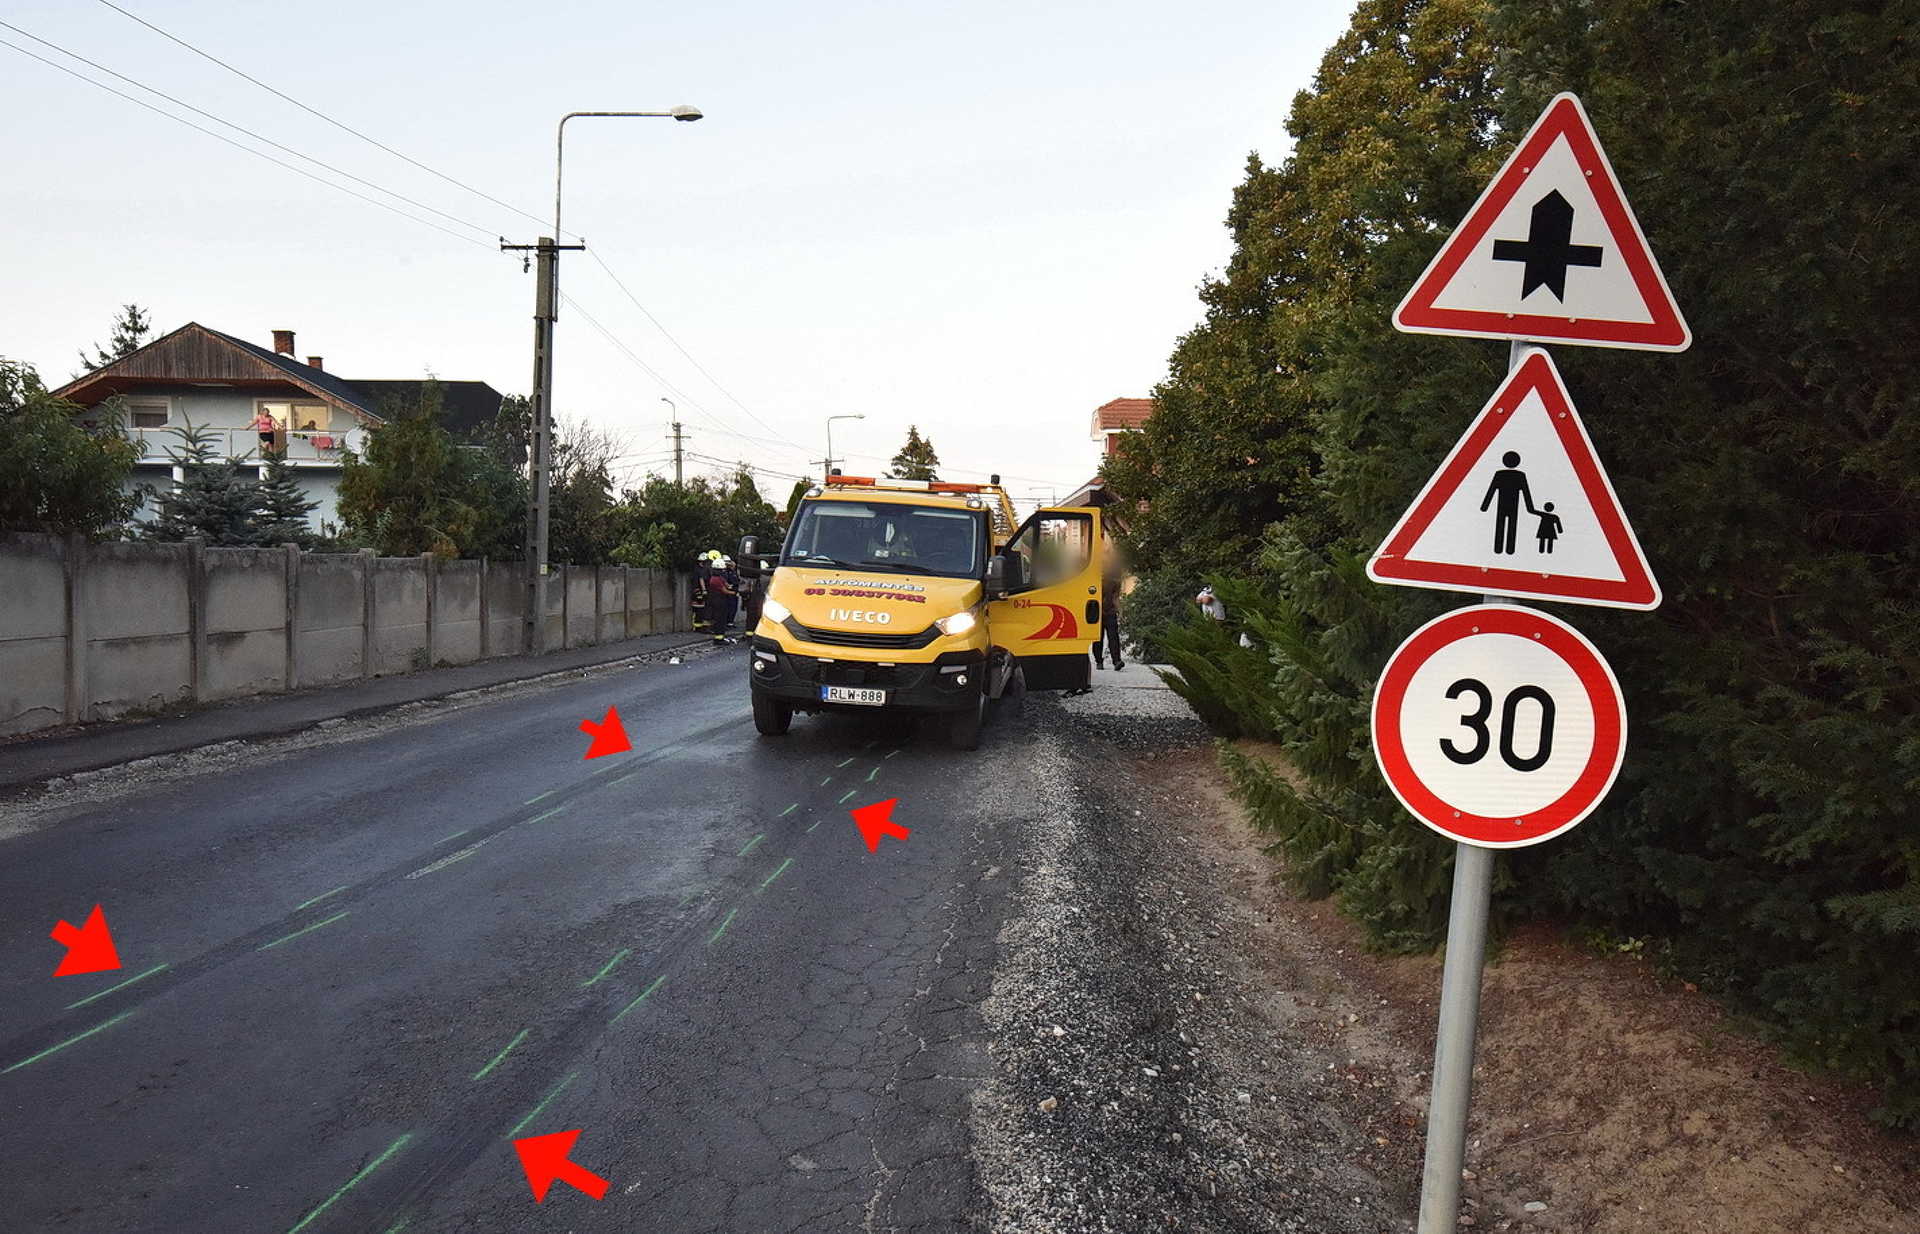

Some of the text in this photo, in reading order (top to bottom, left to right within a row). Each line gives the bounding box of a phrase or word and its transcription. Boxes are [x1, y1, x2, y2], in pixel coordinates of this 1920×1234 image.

[1013, 599, 1031, 609] 0-24
[830, 608, 891, 624] IVECO
[830, 688, 883, 702] RLW-888
[1439, 678, 1555, 772] 30
